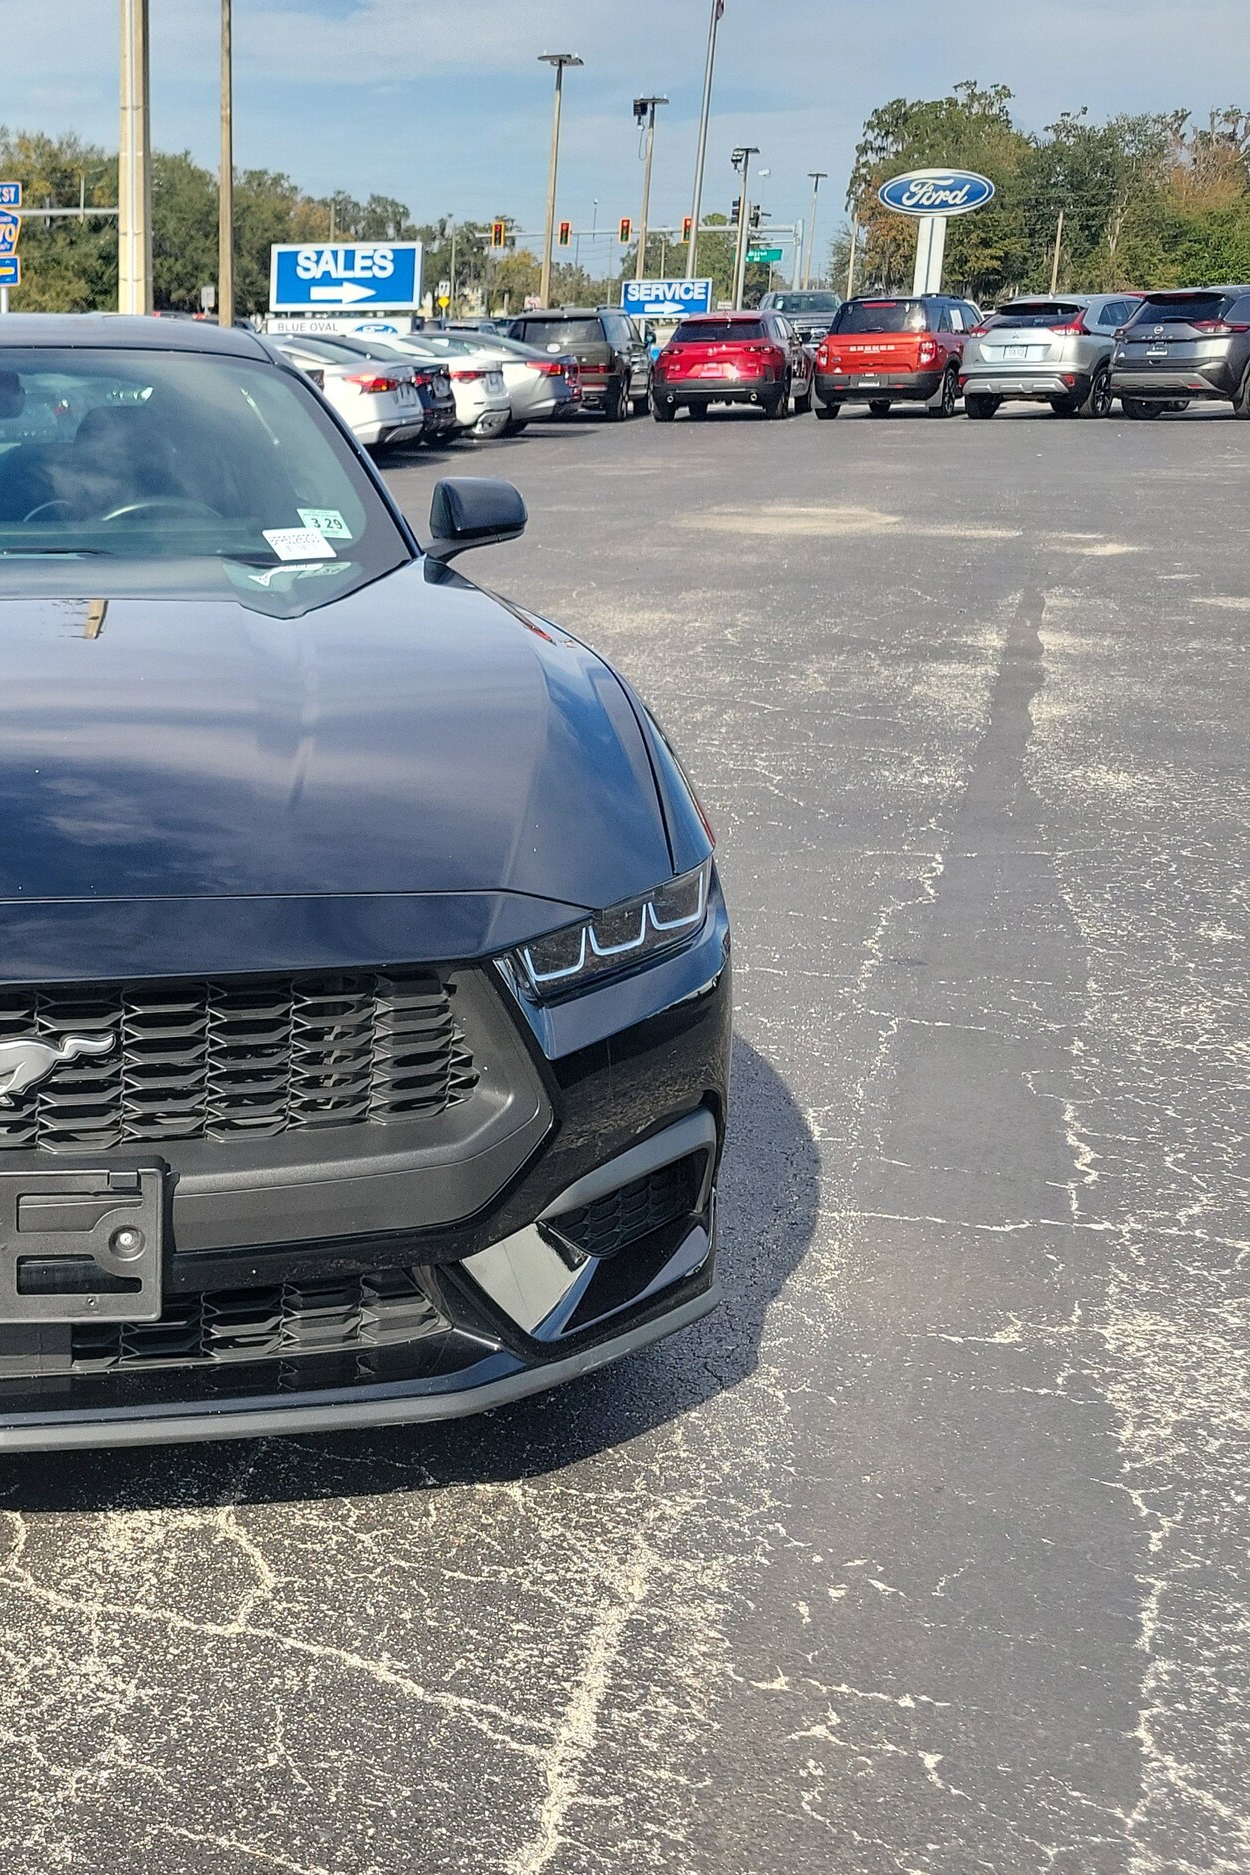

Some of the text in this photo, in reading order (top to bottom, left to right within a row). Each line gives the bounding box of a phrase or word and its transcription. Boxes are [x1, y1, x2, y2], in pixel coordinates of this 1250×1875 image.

[901, 178, 971, 206] Ford
[296, 248, 395, 280] SALES
[627, 282, 707, 302] SERVICE
[277, 322, 339, 332] BLUE OVAL
[311, 518, 343, 530] 3 29
